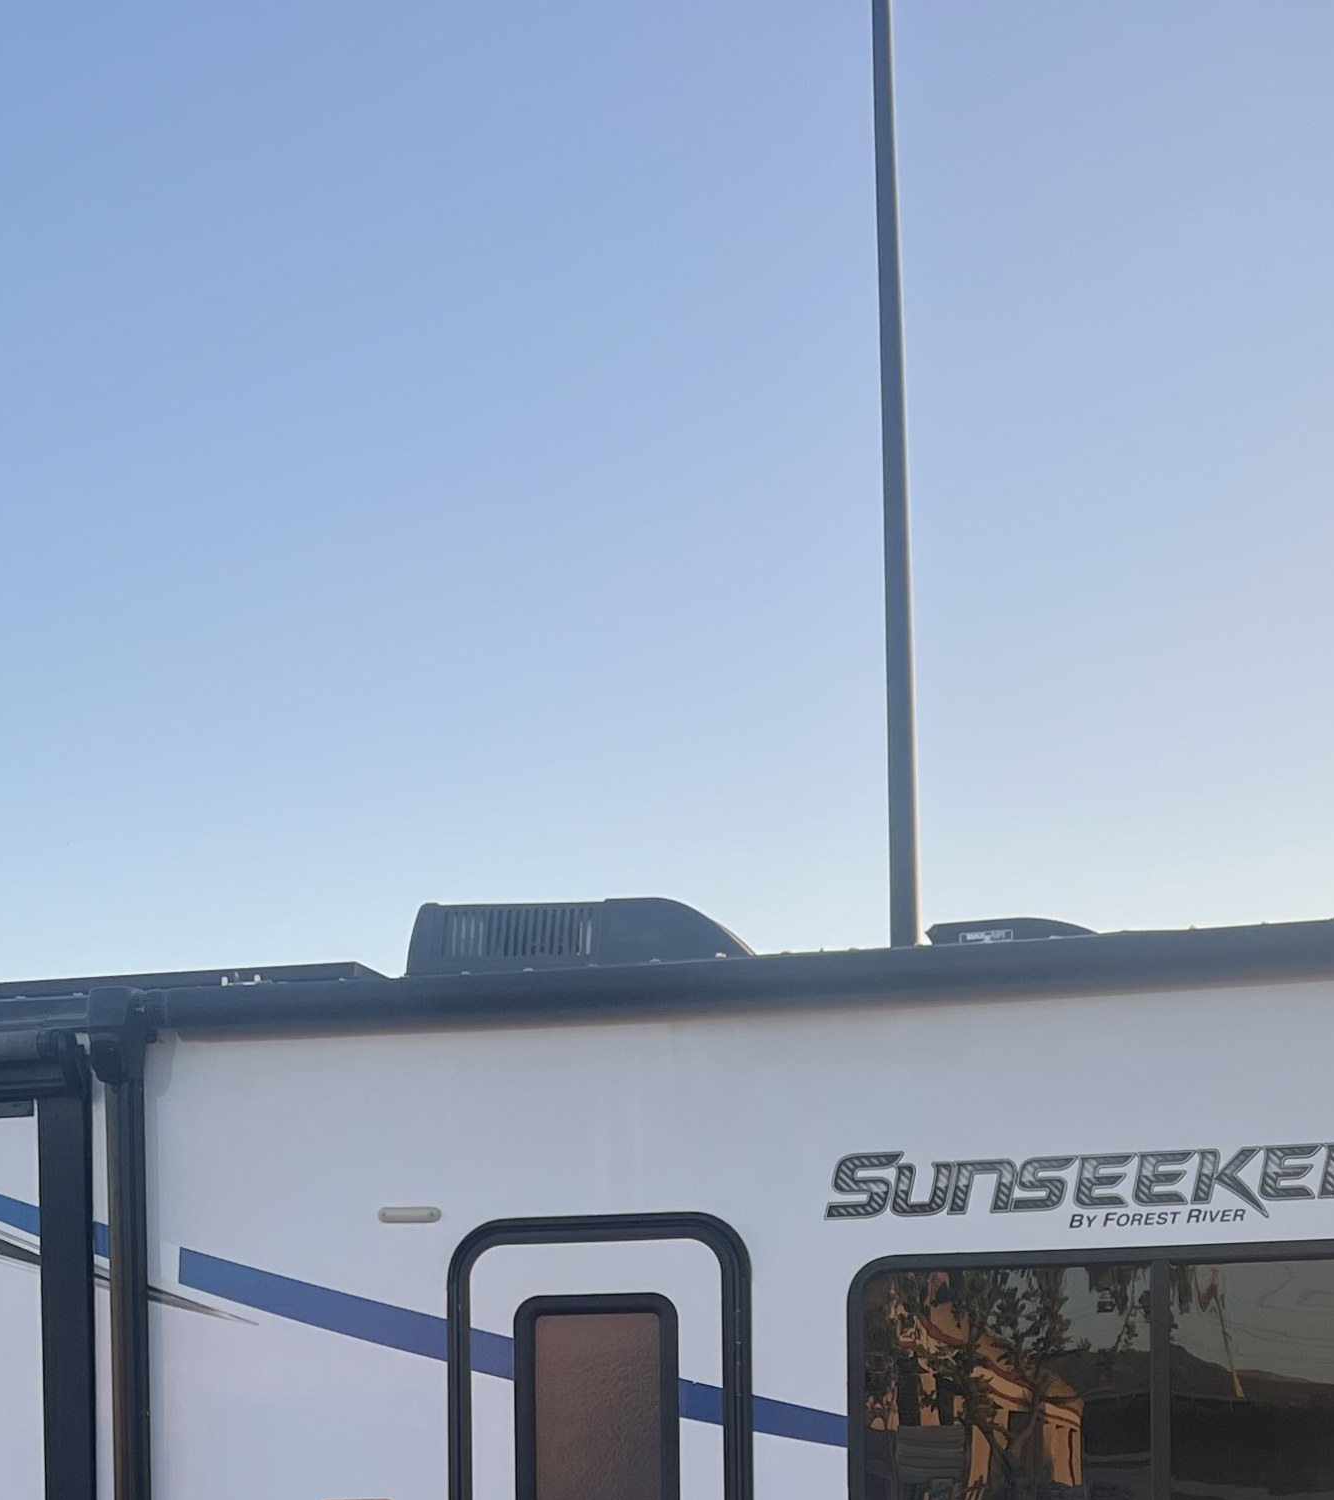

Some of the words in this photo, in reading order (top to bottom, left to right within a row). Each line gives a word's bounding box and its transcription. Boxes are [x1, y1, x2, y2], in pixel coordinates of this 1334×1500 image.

[1069, 1213, 1098, 1229] BY
[1103, 1211, 1181, 1228] FOREST
[1186, 1208, 1246, 1224] RIVER
